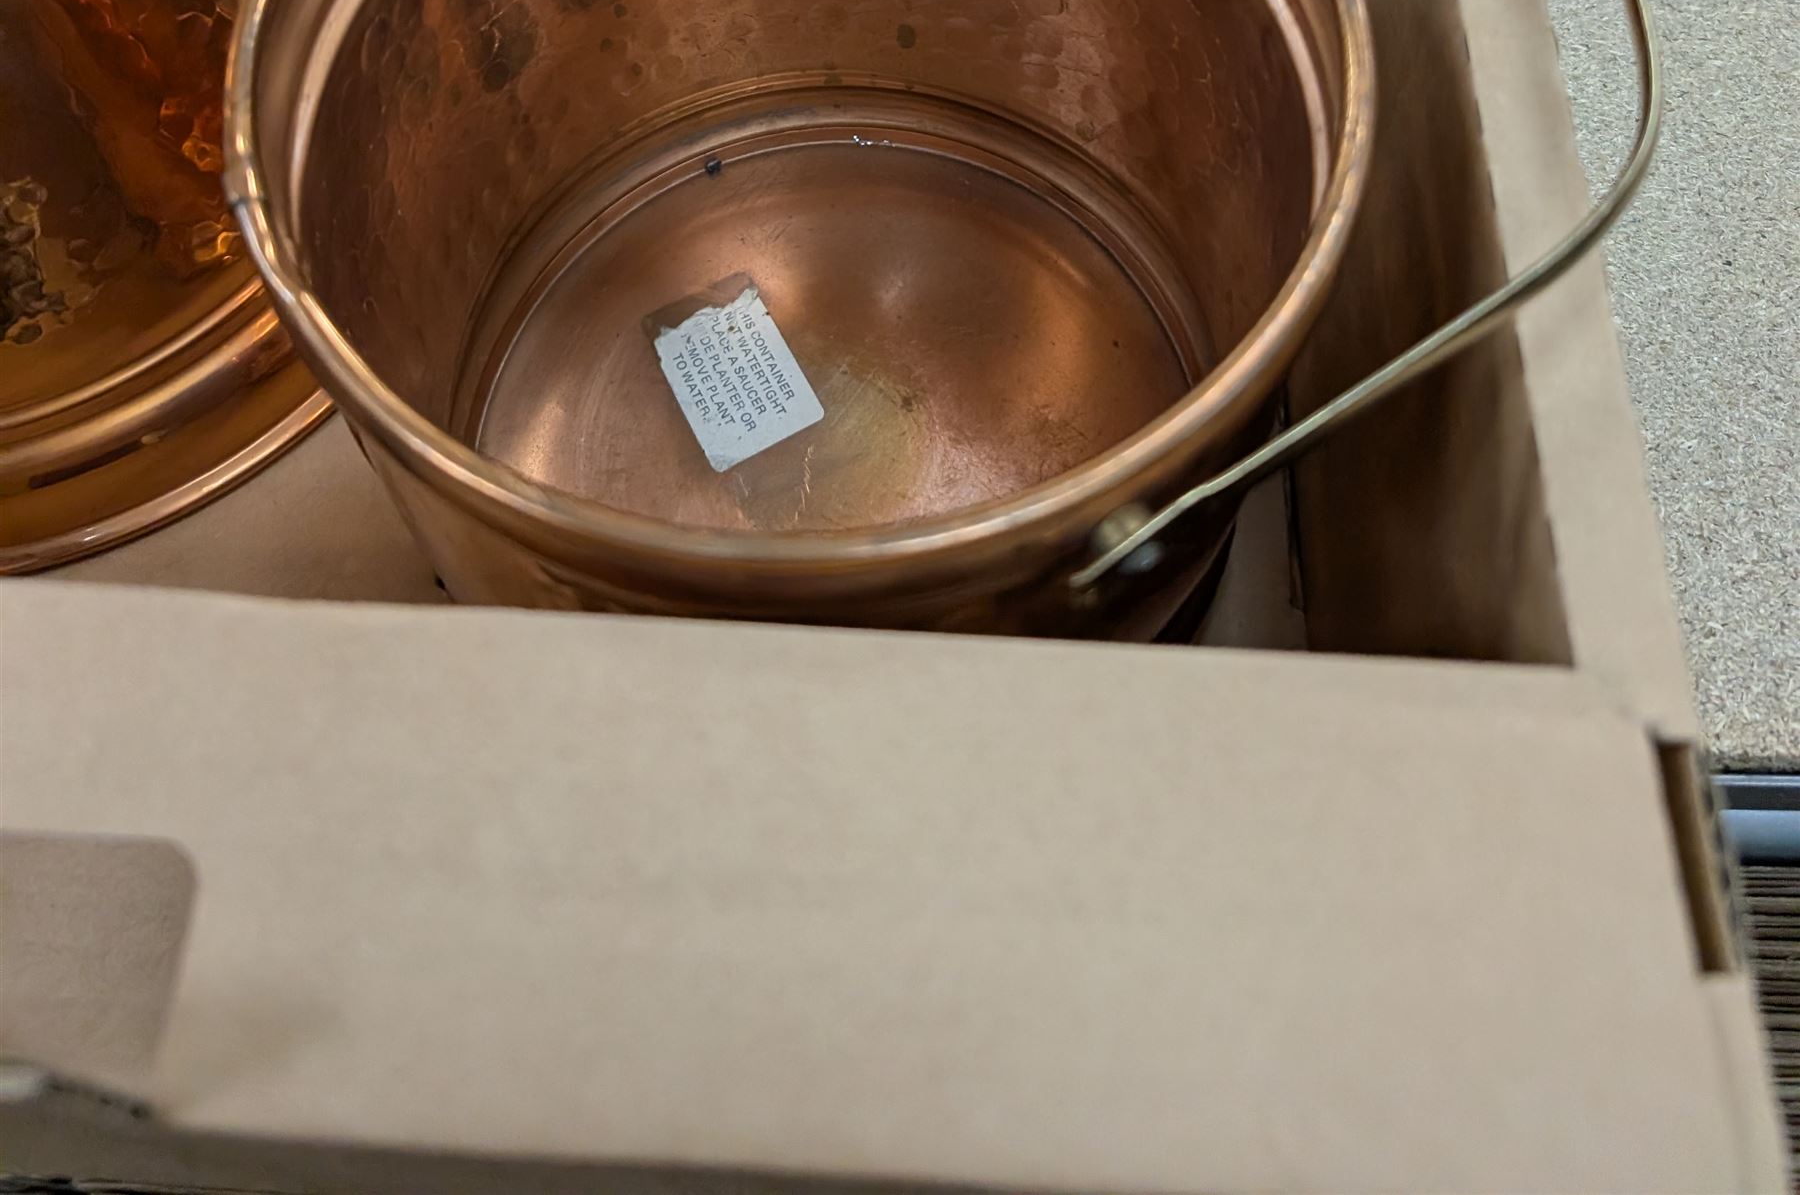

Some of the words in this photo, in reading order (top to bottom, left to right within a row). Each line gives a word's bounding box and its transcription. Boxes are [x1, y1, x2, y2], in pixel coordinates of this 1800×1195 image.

[672, 352, 688, 371] TO
[681, 370, 712, 424] WATER.
[726, 353, 740, 366] A
[732, 364, 767, 415] SAUCER
[749, 328, 795, 401] CONTAINER
[706, 384, 735, 426] PLANT
[707, 352, 746, 412] PLANTER
[739, 410, 757, 432] OR
